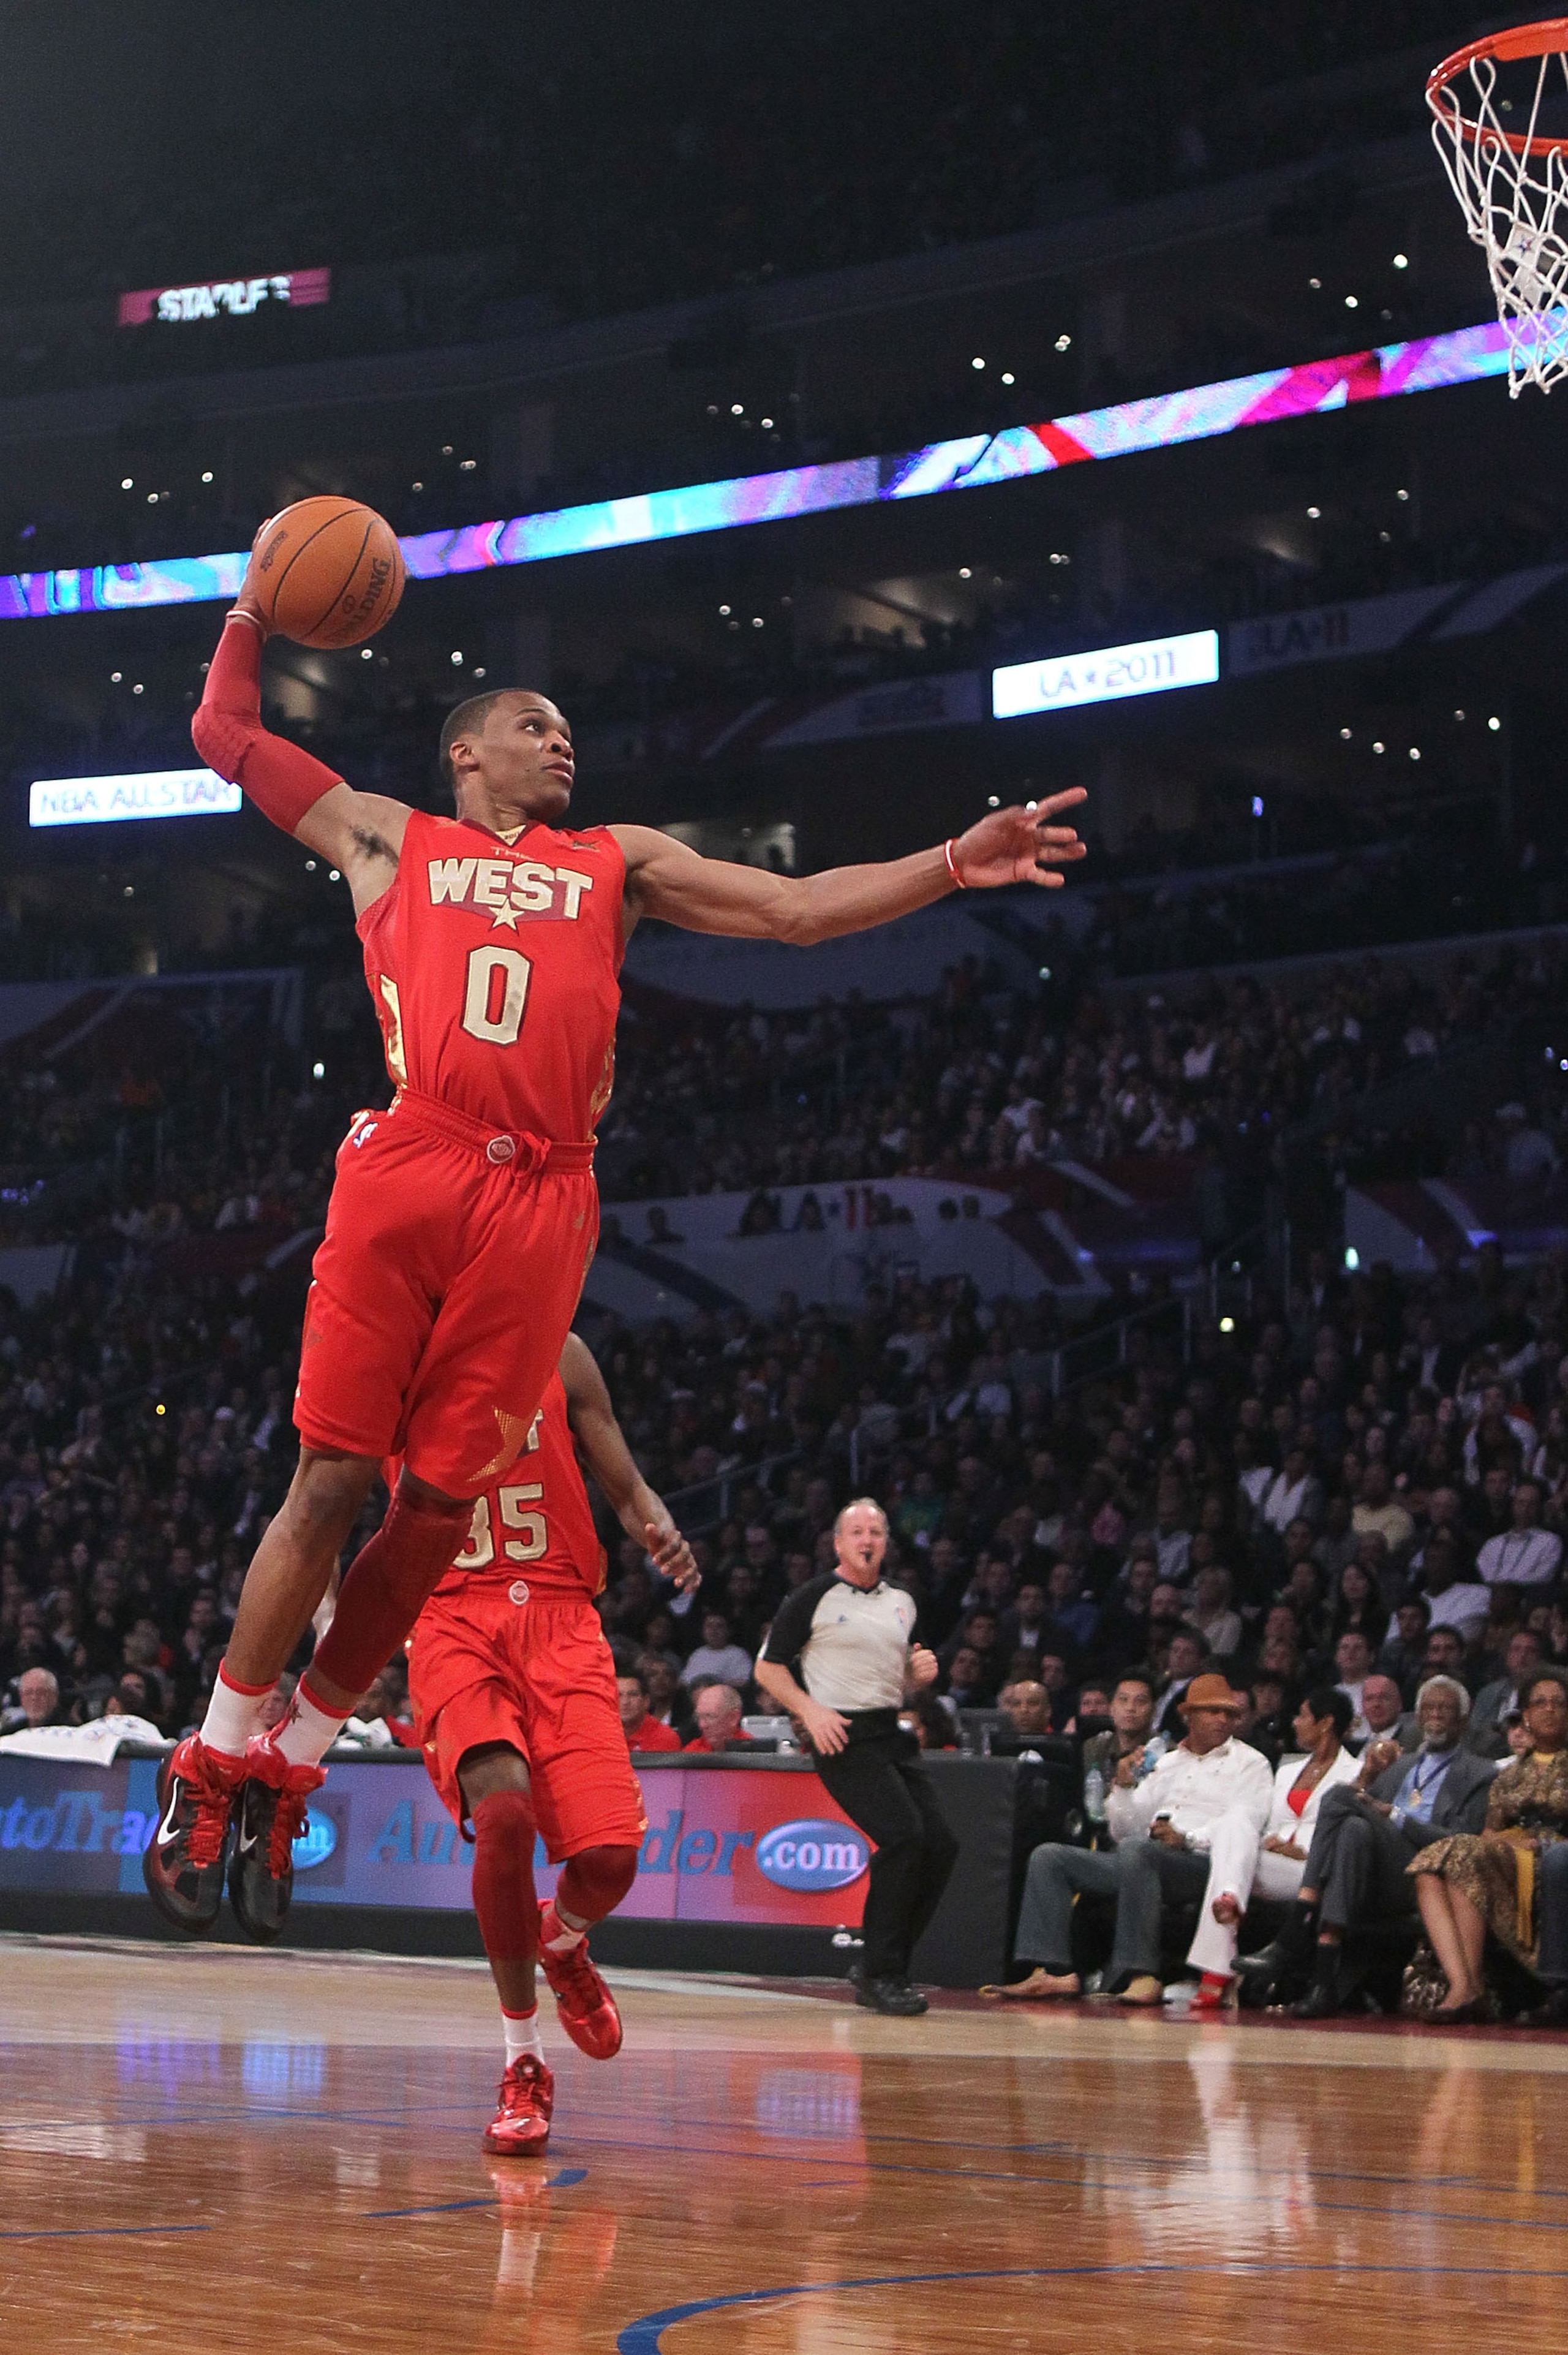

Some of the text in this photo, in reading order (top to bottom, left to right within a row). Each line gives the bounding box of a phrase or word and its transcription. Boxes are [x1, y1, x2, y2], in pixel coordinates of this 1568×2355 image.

[1039, 648, 1177, 698] LA 2011
[40, 788, 100, 814] NBA
[428, 857, 594, 920] WEST
[461, 944, 533, 1047] 0
[452, 1483, 549, 1570] 35
[0, 1790, 160, 1853] toTra
[763, 1841, 861, 1871] .com
